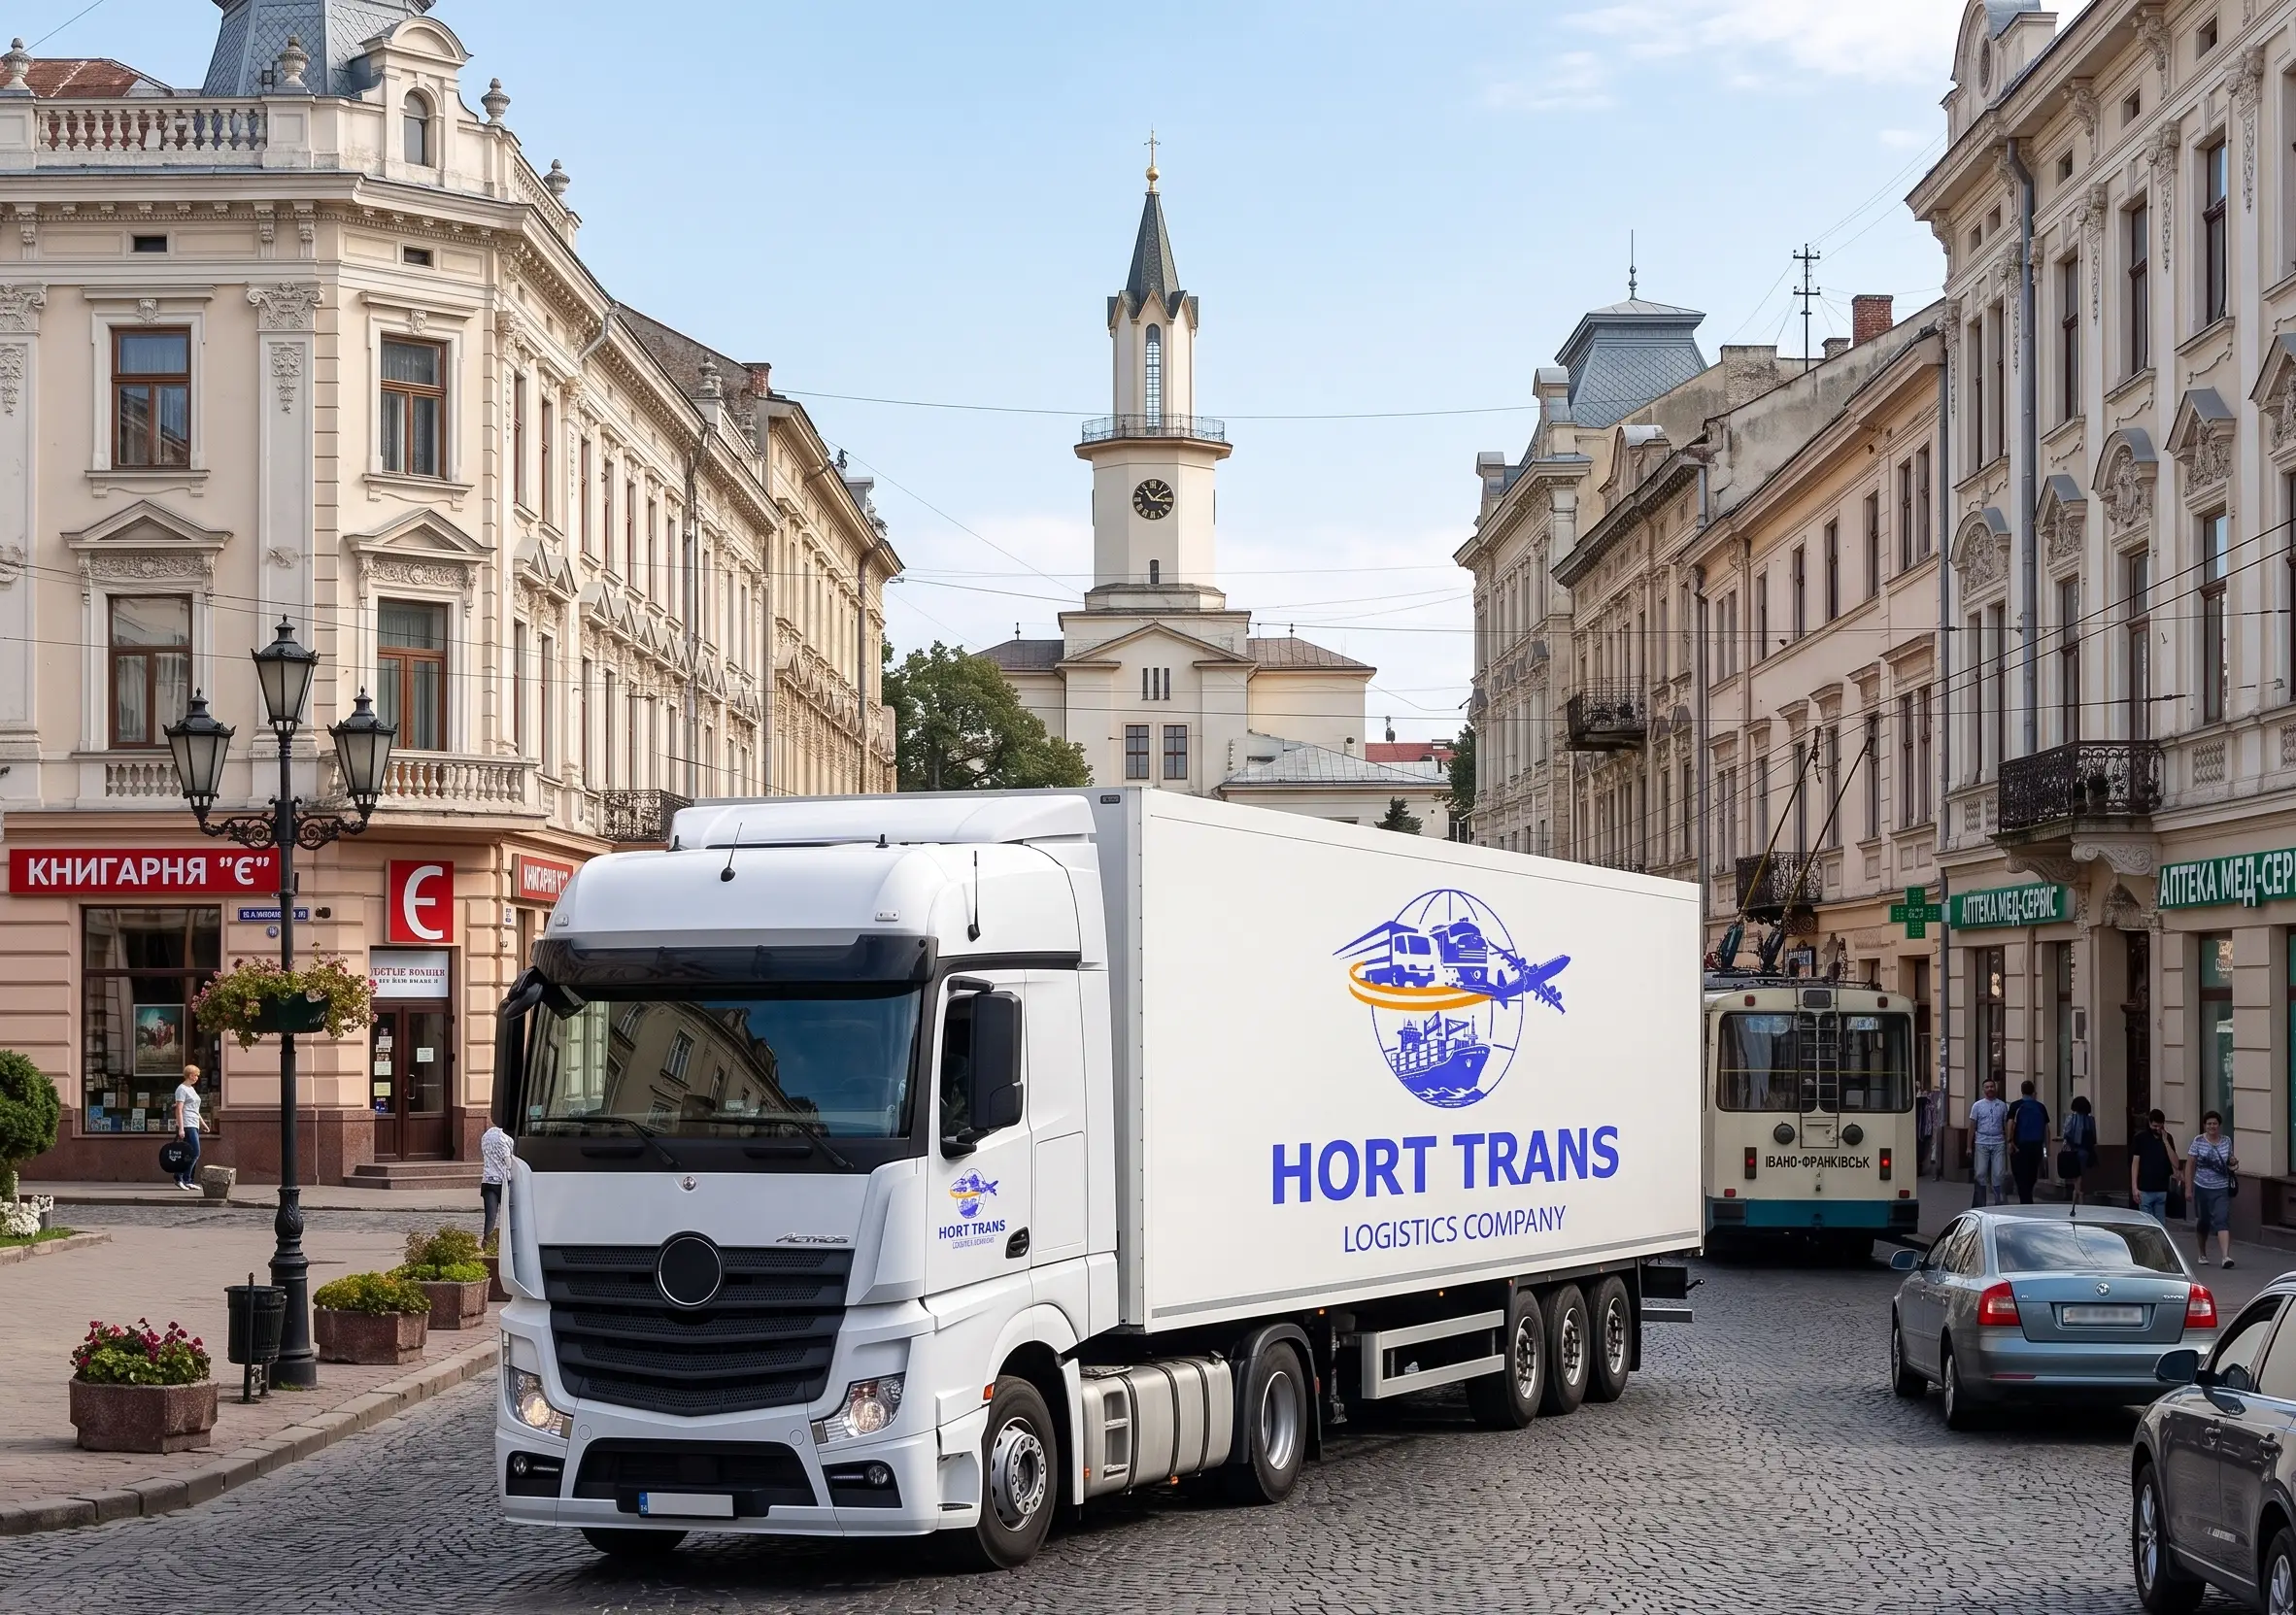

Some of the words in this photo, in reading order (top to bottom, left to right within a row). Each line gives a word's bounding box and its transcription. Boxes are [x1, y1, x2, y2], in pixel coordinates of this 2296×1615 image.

[27, 858, 207, 886] КНИГАРНЯ
[2159, 860, 2217, 906] АПТЕКА
[2221, 851, 2296, 907] МЕД-СЕР
[403, 864, 444, 940] Є
[1961, 892, 1998, 925] АПТЕКА
[1272, 1134, 1437, 1205] HORT
[1452, 1125, 1620, 1190] TRANS
[938, 1224, 969, 1240] HORT
[971, 1219, 1006, 1235] TRANS
[1344, 1216, 1458, 1253] LOGISTICS
[1464, 1204, 1567, 1240] COMPANY
